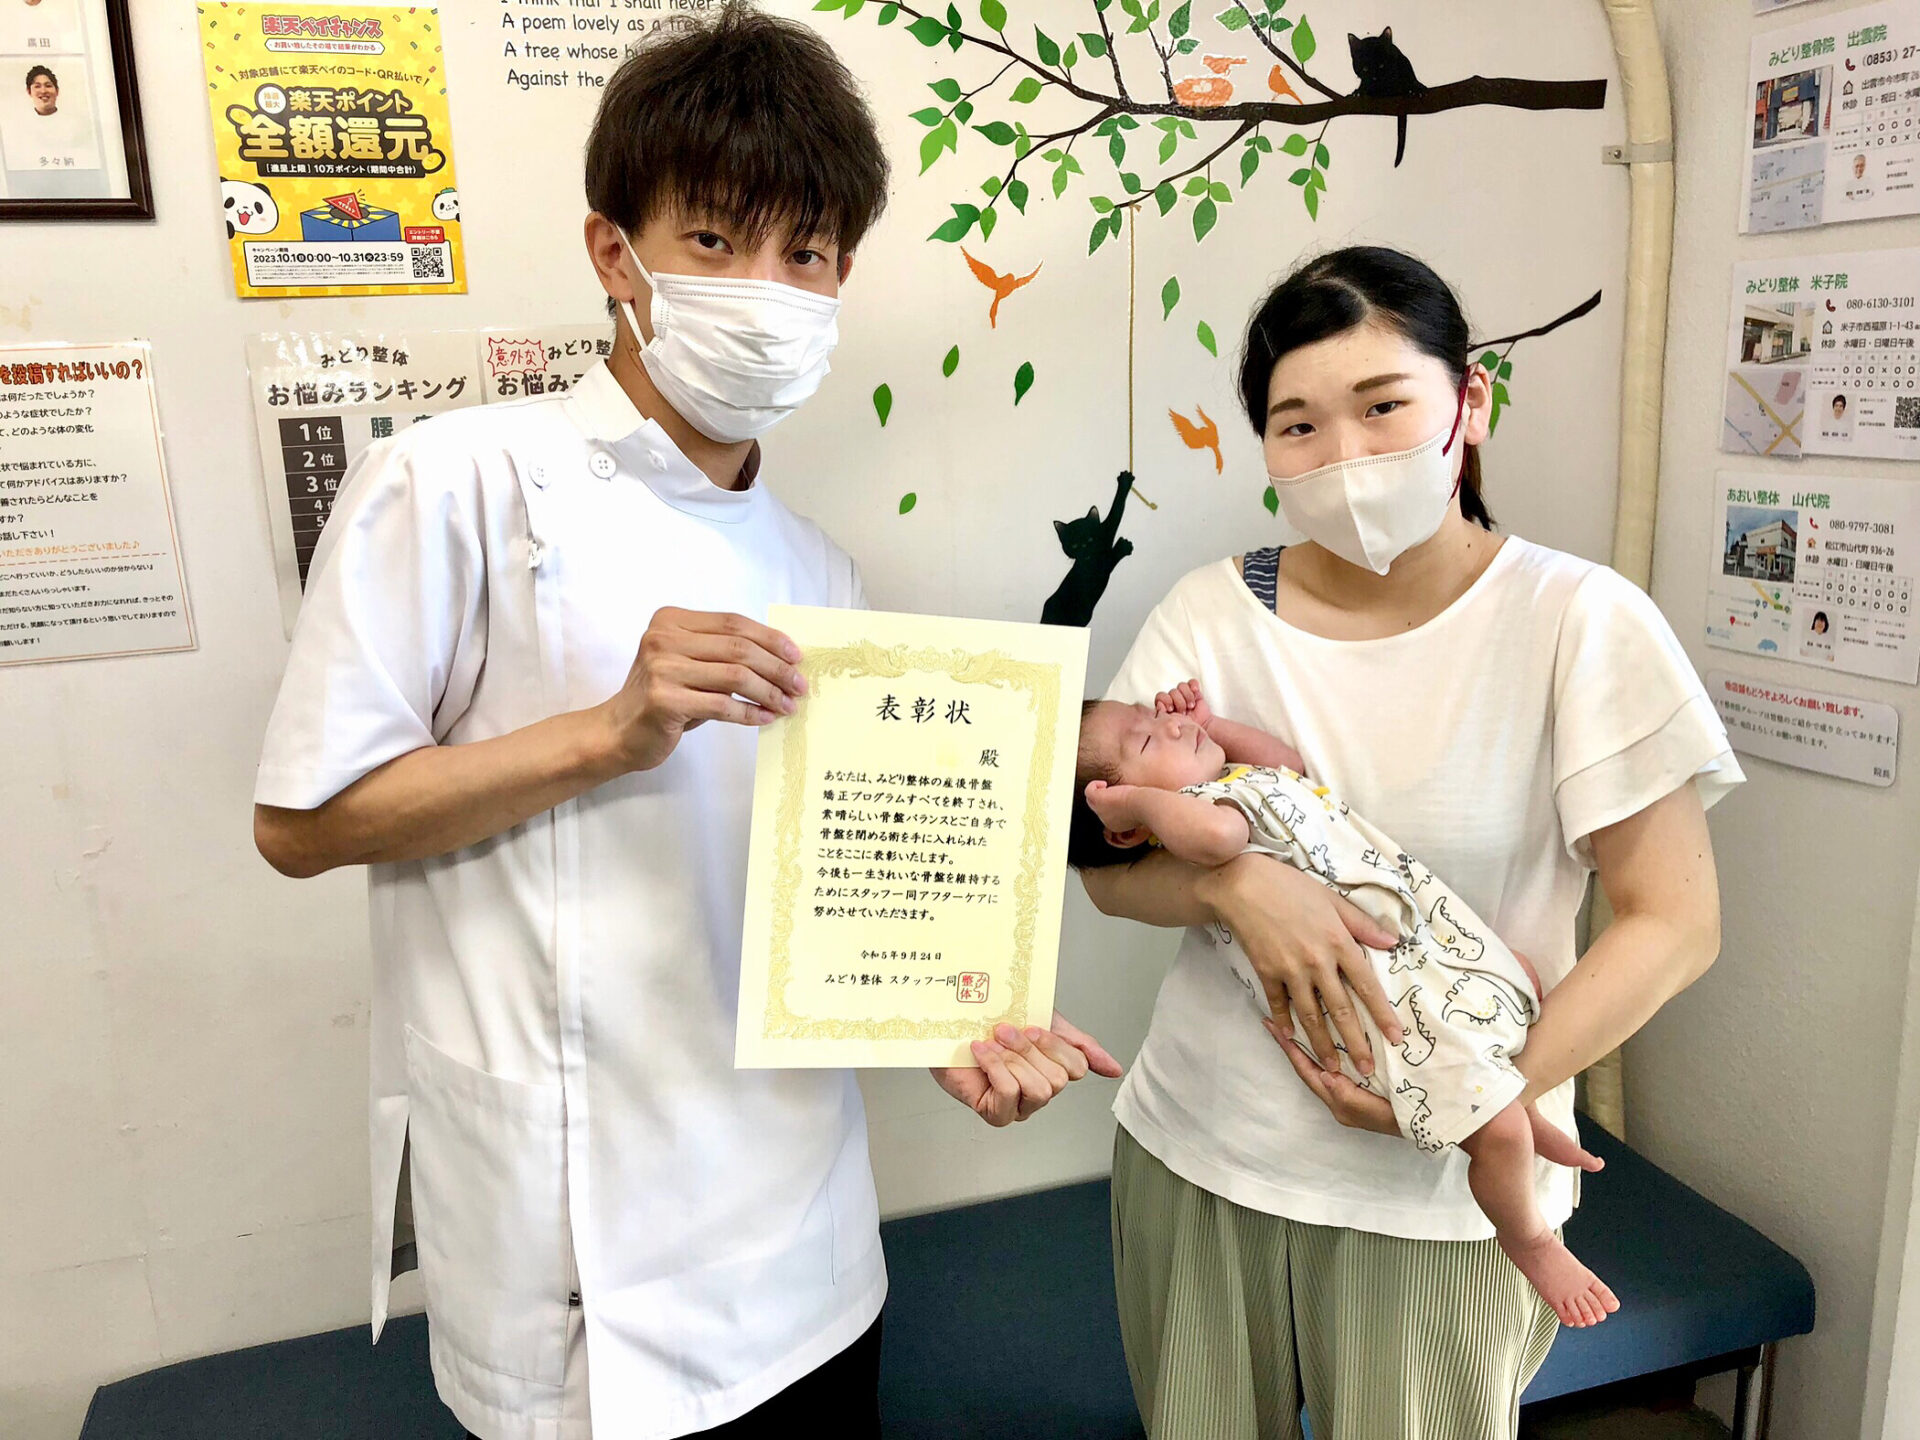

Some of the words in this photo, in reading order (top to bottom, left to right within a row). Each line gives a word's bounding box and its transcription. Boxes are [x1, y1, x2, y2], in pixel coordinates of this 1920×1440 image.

[262, 15, 384, 39] 楽天ペイチャンス
[502, 12, 515, 29] A
[522, 16, 566, 34] poem
[573, 14, 620, 35] lovely
[627, 19, 645, 31] as
[652, 19, 661, 31] a
[504, 41, 517, 58] A
[525, 42, 560, 59] tree
[567, 43, 618, 59] whose
[1769, 36, 1836, 67] みどり整骨院
[1847, 24, 1888, 49] 出雲院
[238, 65, 424, 84] 対象店舗にて楽天ペイのコード・QR払いで
[507, 68, 568, 91] Against
[577, 70, 605, 87] the
[288, 89, 411, 114] 楽天ポイント
[240, 112, 429, 161] 全額還元
[1746, 276, 1800, 294] みどり整体
[1810, 273, 1849, 291] 米子院
[1846, 296, 1916, 311] 080-6130-3101
[1843, 337, 1915, 349] 水曜日・日曜日午後
[321, 346, 410, 369] みどり整体
[495, 346, 537, 367] 意外な
[267, 375, 468, 406] お悩みランキング
[299, 422, 333, 442] 1位
[0, 458, 97, 473] 状で悩まれている方に、
[302, 450, 336, 468] 2位
[306, 475, 339, 493] 3位
[1727, 488, 1780, 507] あおい整体
[1792, 492, 1830, 510] 山代院
[1829, 519, 1896, 535] 080-9797-3081
[875, 694, 973, 725] 表彰状
[979, 748, 1000, 768] 殿
[824, 769, 993, 791] あなたは、みどり整体の産後骨盤
[823, 789, 1005, 812] 矯正プログラムすべてを終了され、
[821, 808, 1007, 830] 素晴らしい骨盤バランスとご自身で
[820, 827, 988, 847] 骨盤を閉める術を手に入れられた
[817, 847, 954, 865] ことをここに表彰いたします。
[816, 866, 1001, 886] 今後も一生きれいな骨盤を維持する
[814, 886, 998, 904] ためにスタッフ一同アフターケアに
[813, 905, 935, 922] 努めさせていただきます。
[825, 973, 883, 986] みどり整体
[889, 974, 957, 987] スタッフ一同
